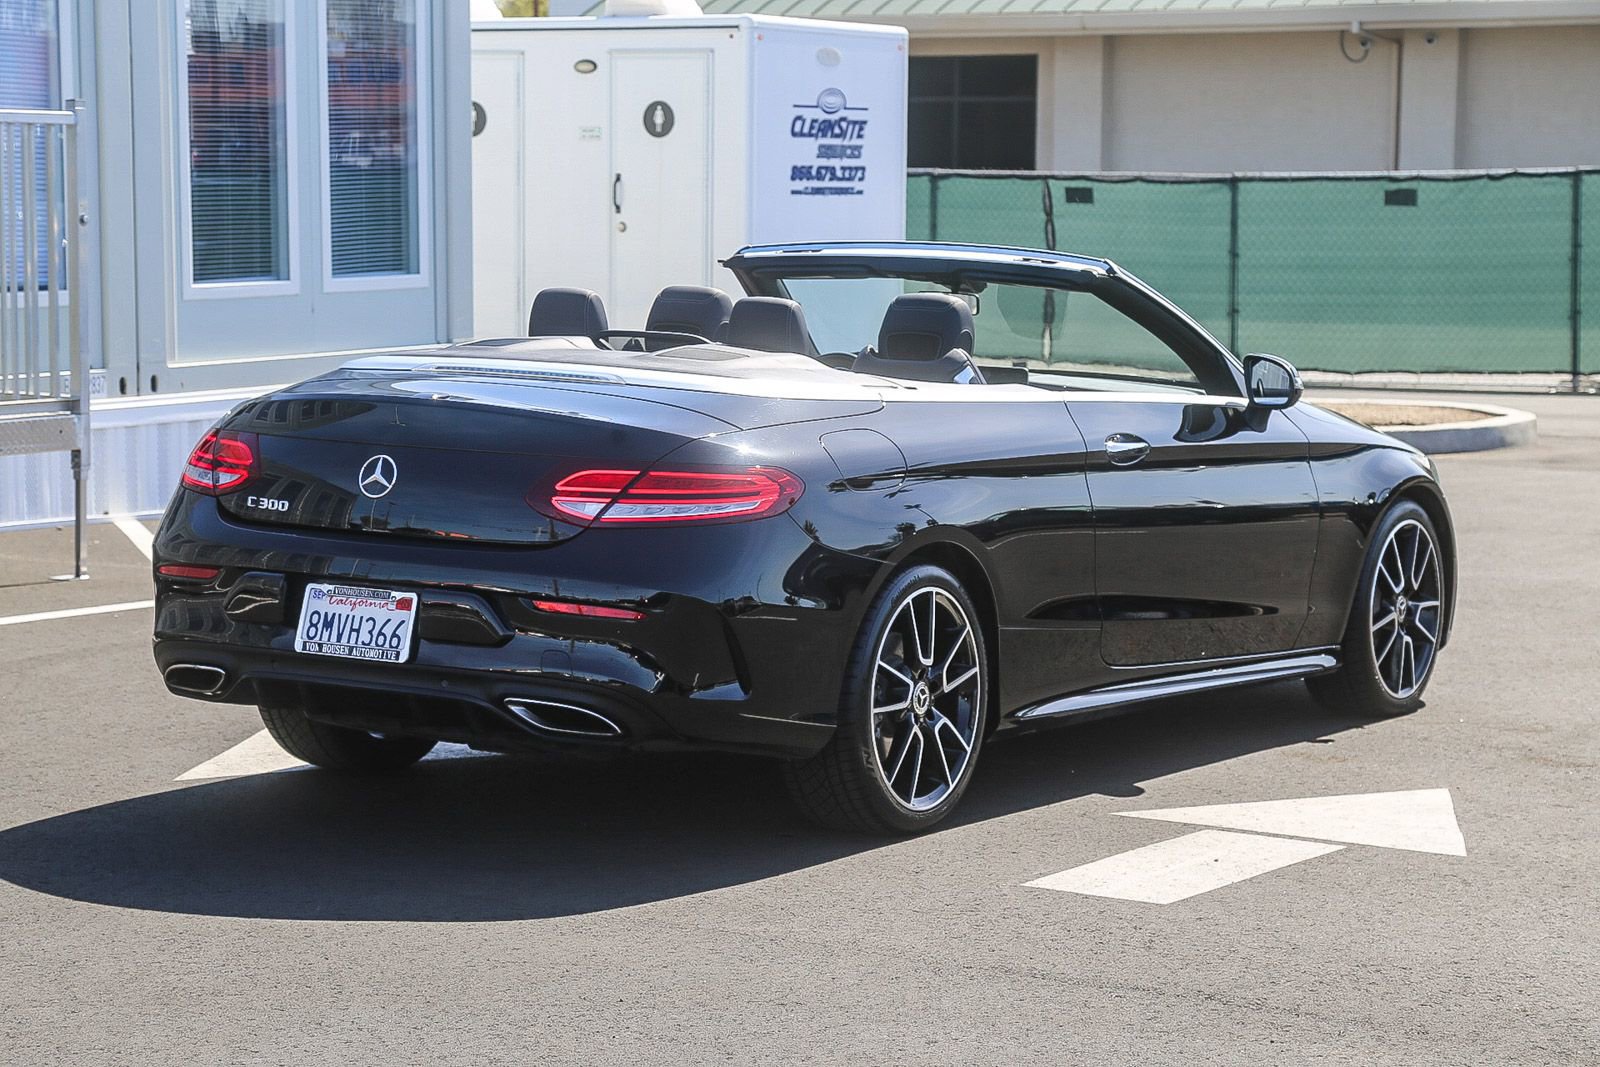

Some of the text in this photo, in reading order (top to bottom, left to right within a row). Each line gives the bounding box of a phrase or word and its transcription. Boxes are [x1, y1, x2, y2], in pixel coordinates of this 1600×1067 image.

[247, 496, 289, 511] C 300
[334, 586, 391, 599] VONHOUSEN.COM
[327, 595, 395, 612] California
[306, 610, 406, 649] 8MVH366
[351, 646, 397, 660] AUTOMOTIVE
